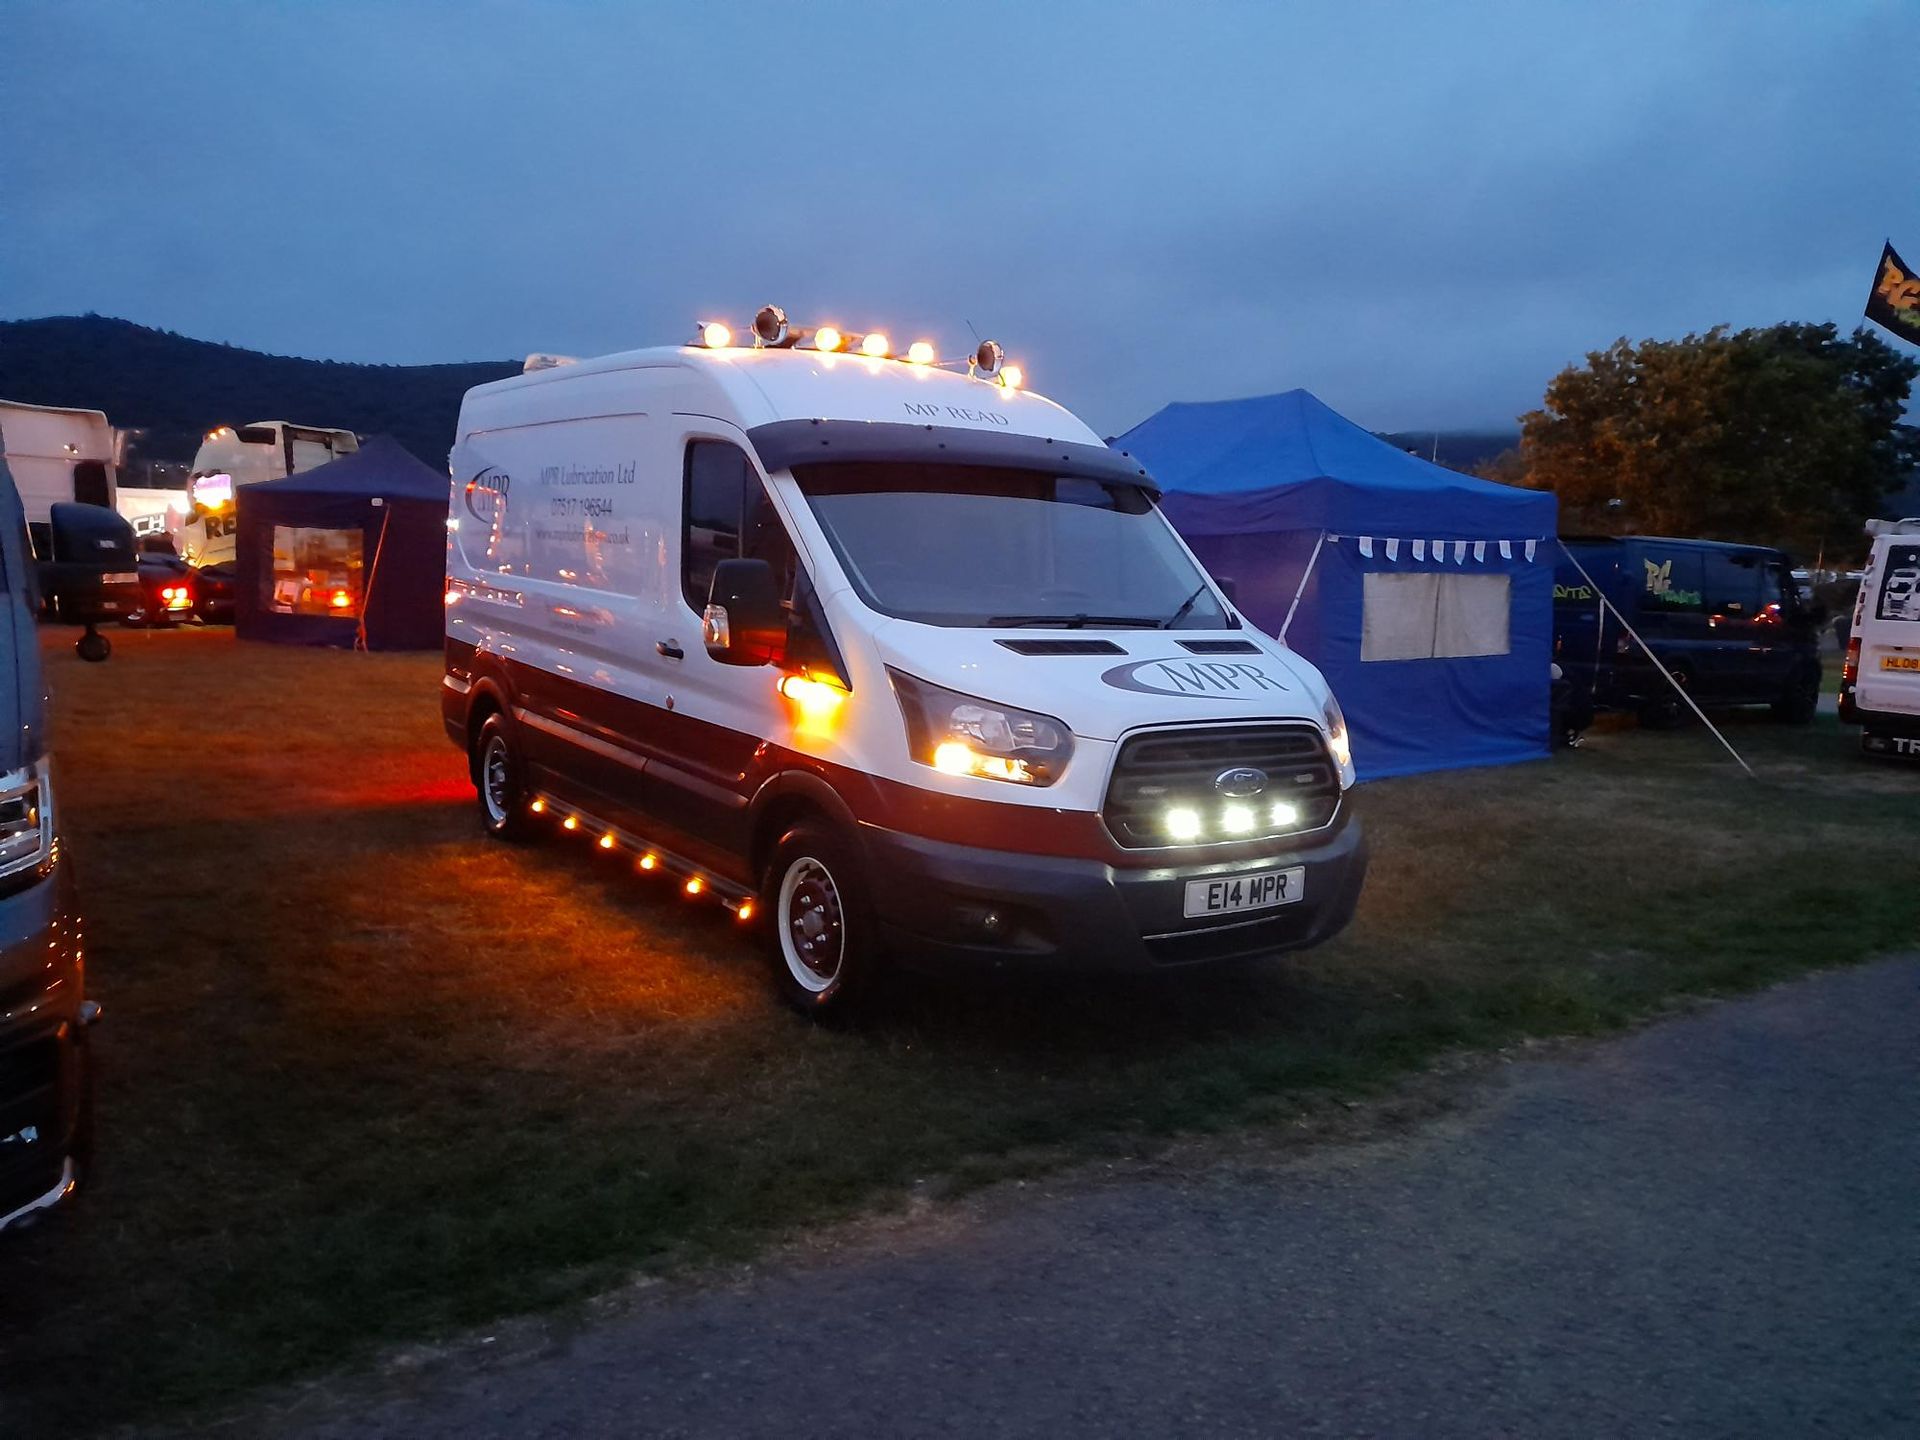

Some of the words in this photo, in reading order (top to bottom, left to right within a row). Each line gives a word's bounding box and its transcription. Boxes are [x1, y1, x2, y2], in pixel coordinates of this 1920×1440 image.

[903, 402, 939, 417] MP
[945, 406, 1009, 426] READ
[561, 463, 615, 486] Lubrication
[617, 459, 637, 485] Ltd
[1155, 662, 1290, 692] MPR
[1207, 881, 1243, 911] E14
[1248, 873, 1289, 906] MPR
